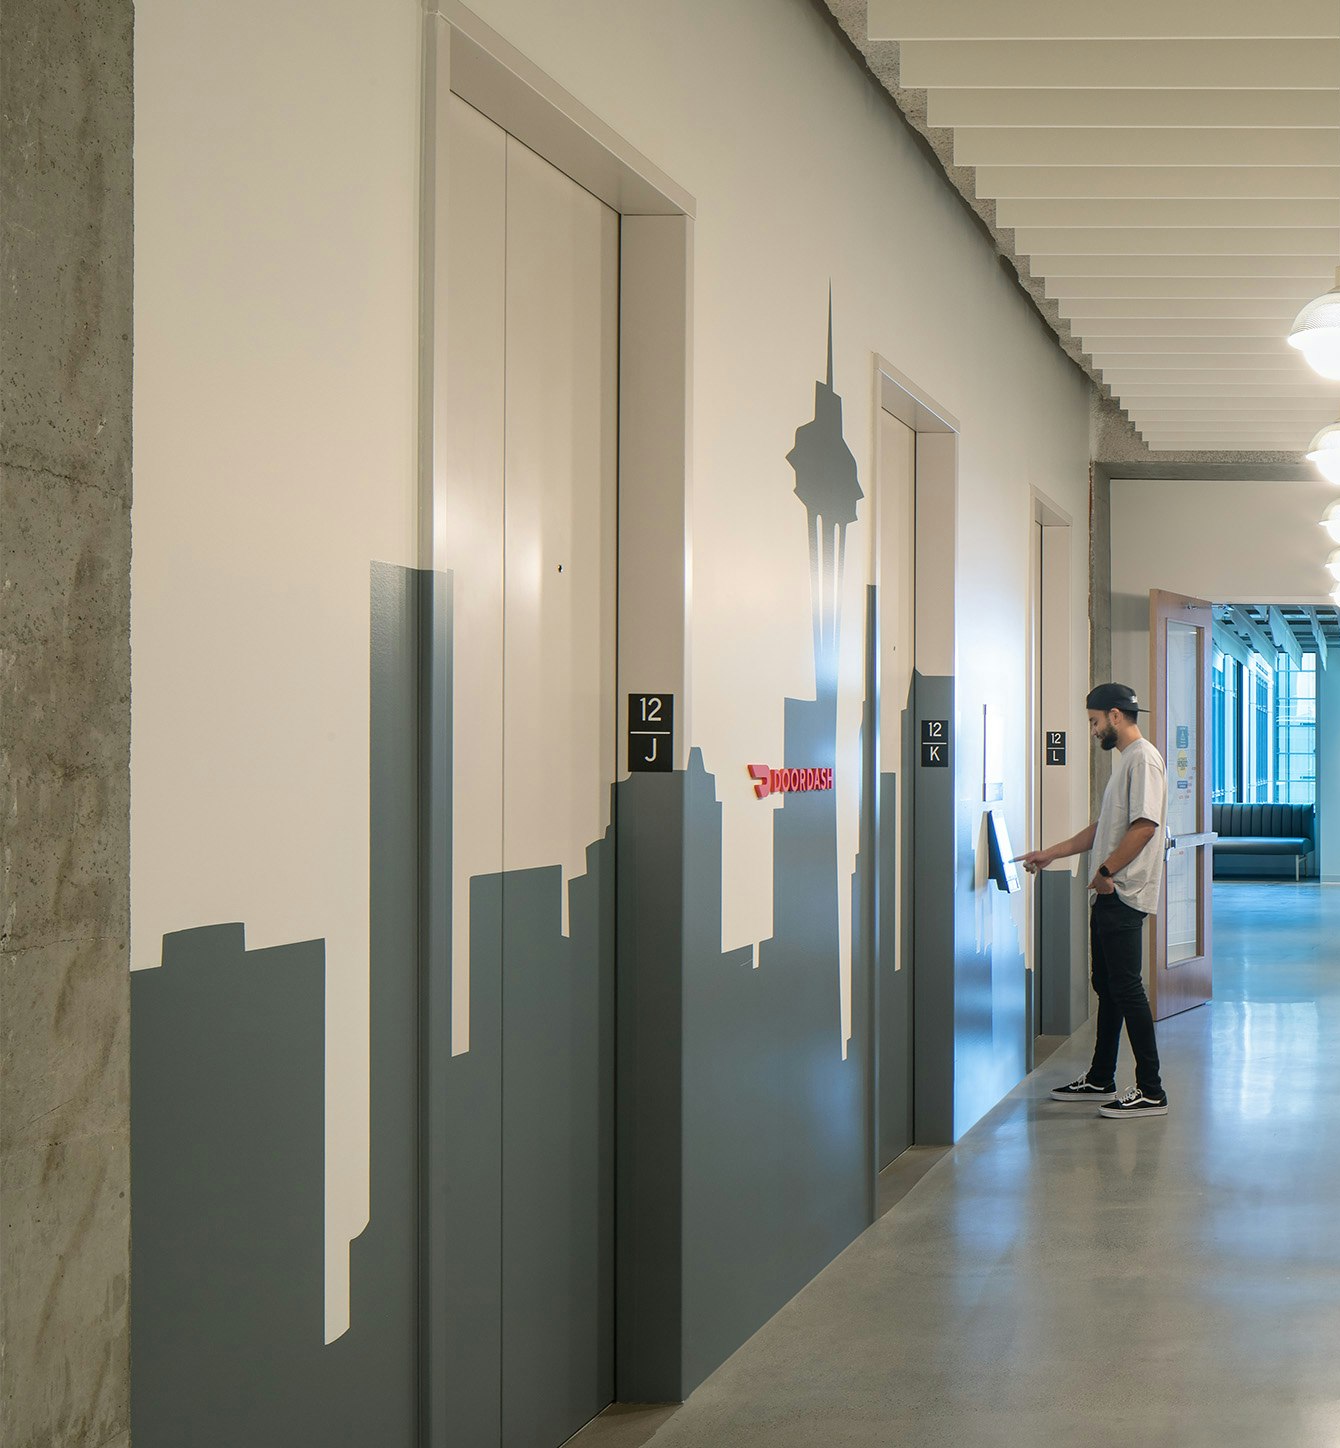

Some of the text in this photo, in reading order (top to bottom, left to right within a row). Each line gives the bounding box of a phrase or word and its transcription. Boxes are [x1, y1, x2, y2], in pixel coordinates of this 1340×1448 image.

[639, 697, 662, 722] 12
[928, 722, 942, 737] 12
[1051, 732, 1062, 744] 12
[644, 737, 657, 762] J
[930, 746, 940, 762] K
[1052, 750, 1059, 762] L
[769, 768, 833, 792] DOORDASH
